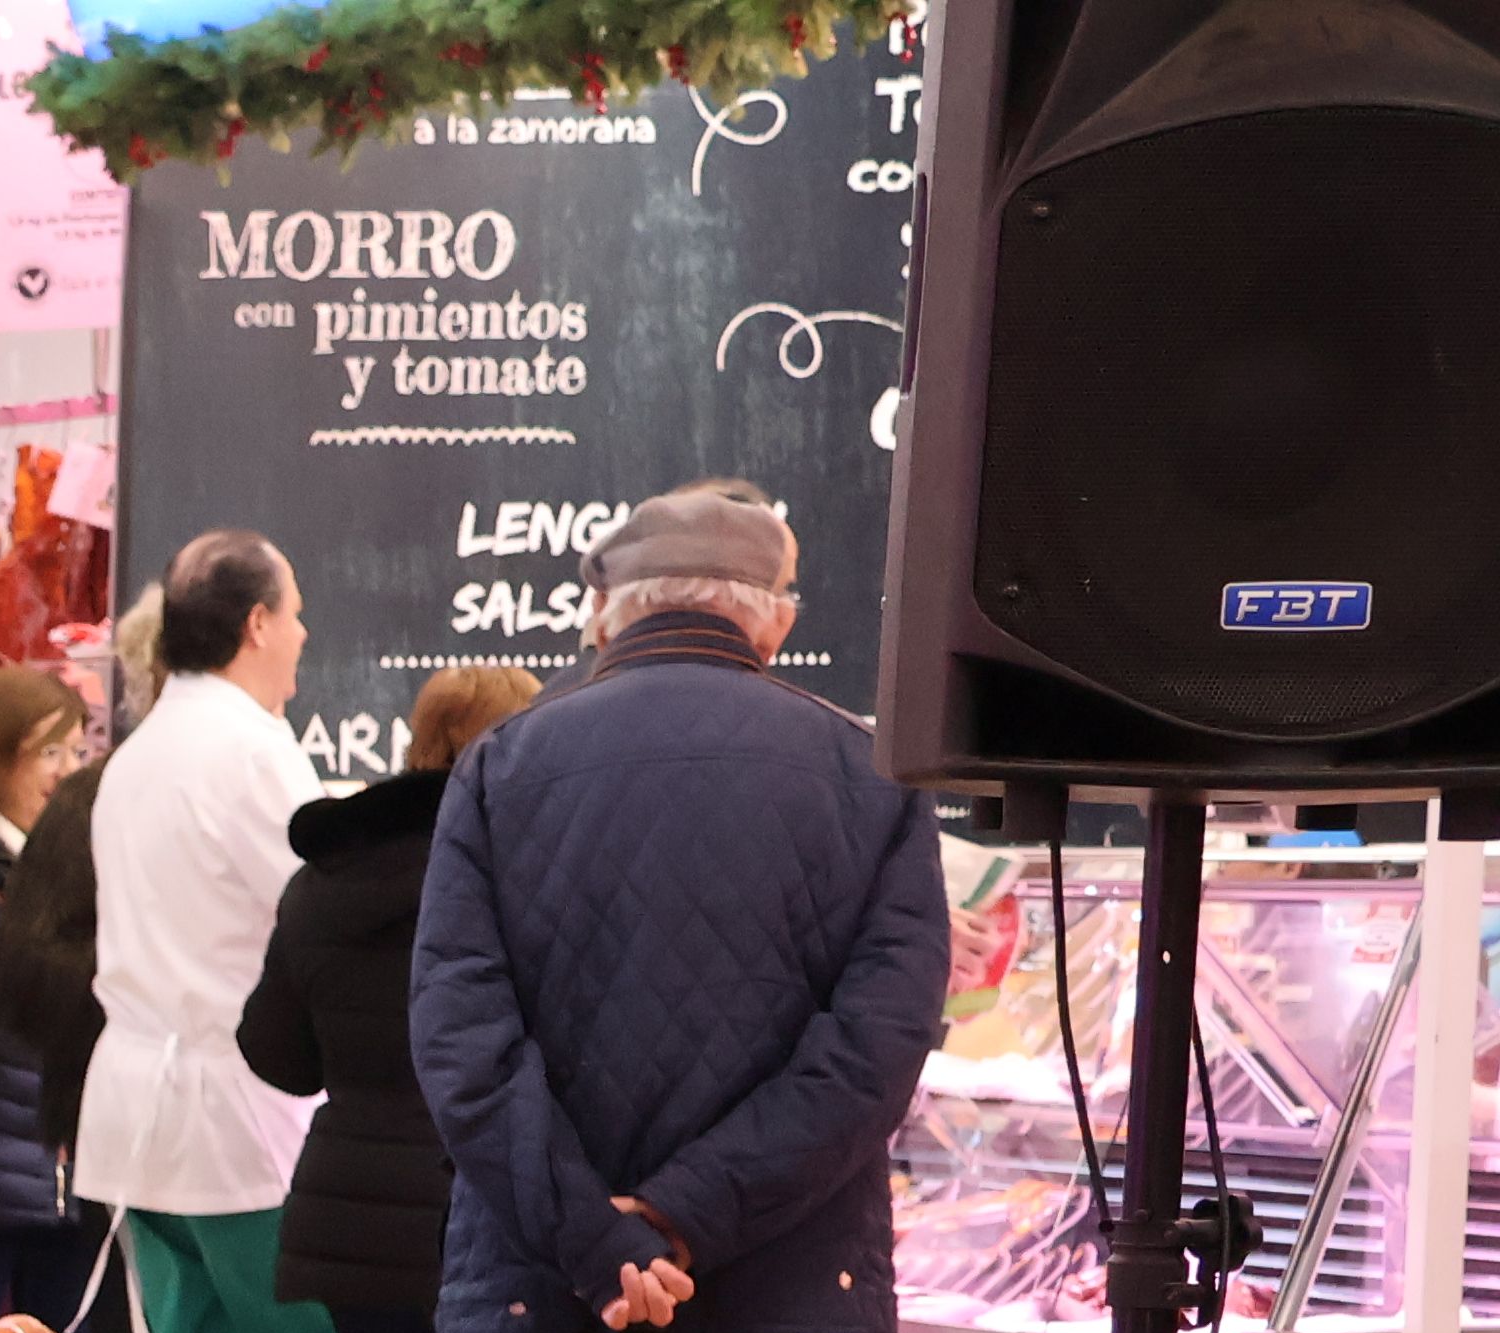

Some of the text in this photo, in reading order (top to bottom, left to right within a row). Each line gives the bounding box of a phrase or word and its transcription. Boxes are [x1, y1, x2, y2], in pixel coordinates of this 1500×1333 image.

[413, 115, 657, 145] a la zamorana
[875, 75, 924, 134] T
[846, 160, 916, 193] co
[198, 208, 518, 282] MORRO
[233, 286, 588, 355] con pimientos
[340, 342, 588, 410] y tomate
[1235, 590, 1358, 622] FBT
